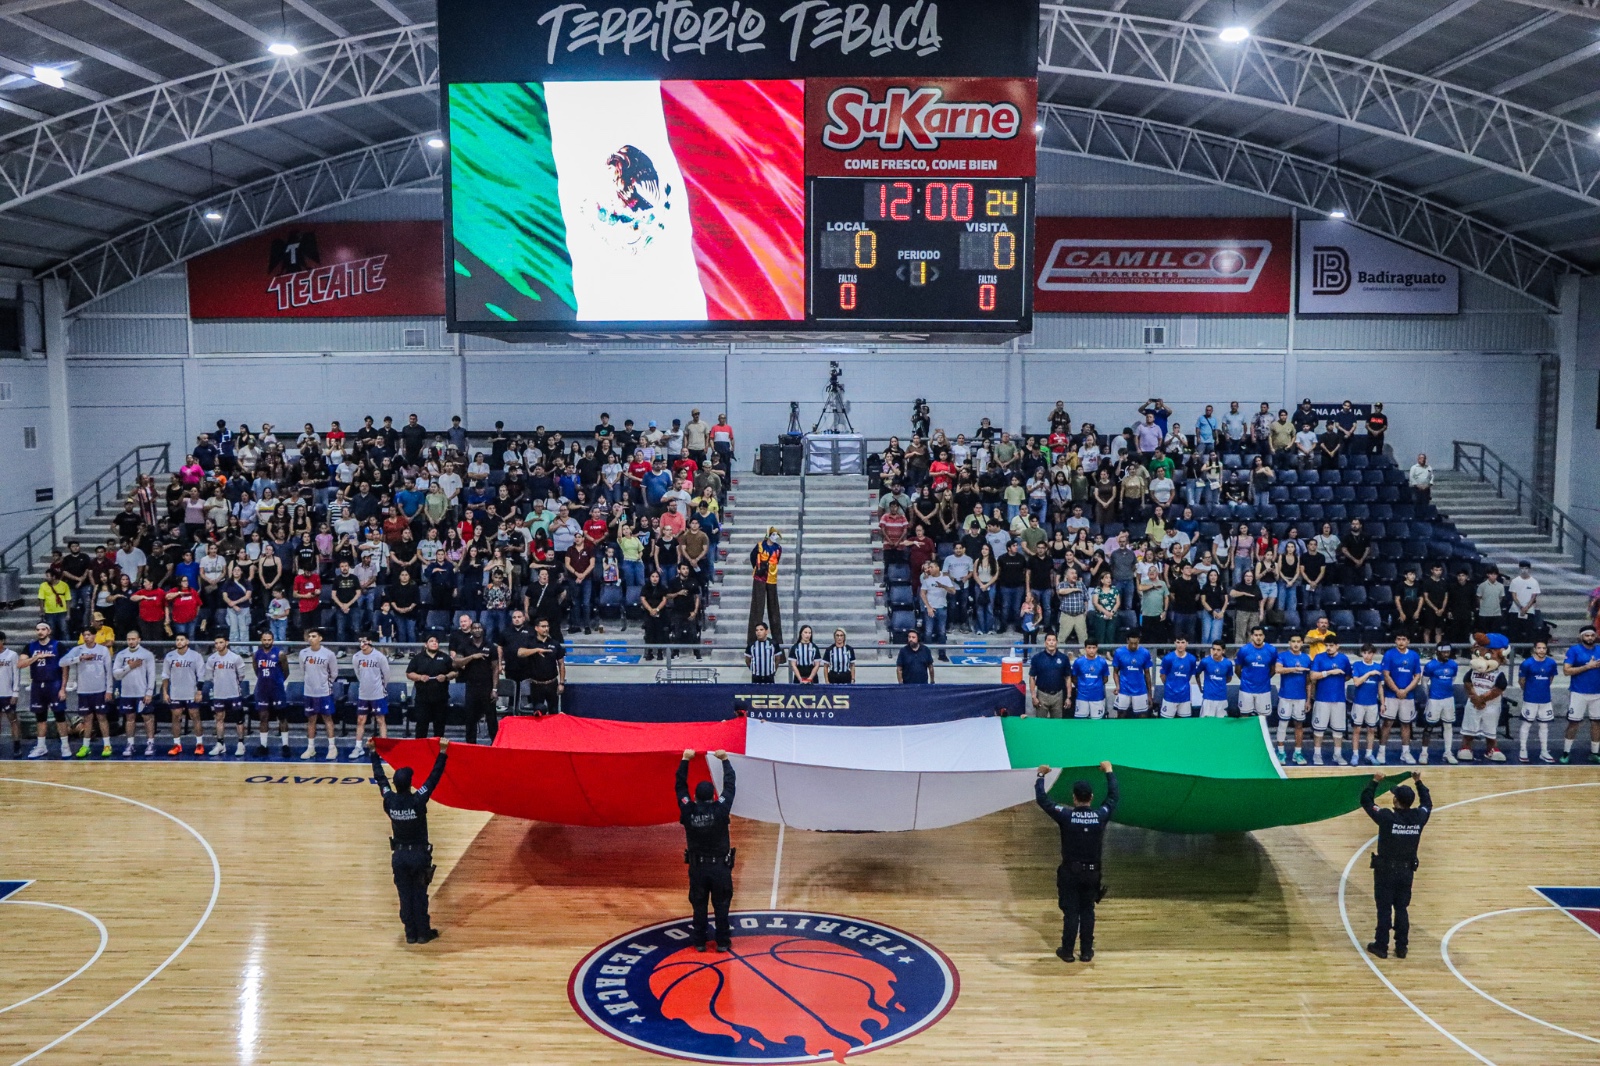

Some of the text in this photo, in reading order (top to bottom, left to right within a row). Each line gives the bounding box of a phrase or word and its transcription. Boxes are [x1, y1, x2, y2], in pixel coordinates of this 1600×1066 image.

[779, 0, 943, 62] TEBACA
[823, 88, 1020, 149] SuKarne
[844, 159, 998, 172] COME FRESCO, COME BIEN
[985, 189, 1018, 216] 24
[826, 222, 870, 232] LOCAL
[966, 222, 1009, 232] VISITA
[898, 250, 941, 260] PERIODO
[1065, 251, 1206, 267] CAMILO
[267, 254, 388, 311] TECATE
[838, 274, 858, 284] FALTAS
[978, 275, 998, 285] FALTAS
[1357, 271, 1447, 287] Badiraguato
[262, 668, 270, 676] 15
[734, 694, 850, 709] TEBACAS
[664, 916, 906, 956] TERRITOO
[594, 942, 657, 1017] TEBACA
